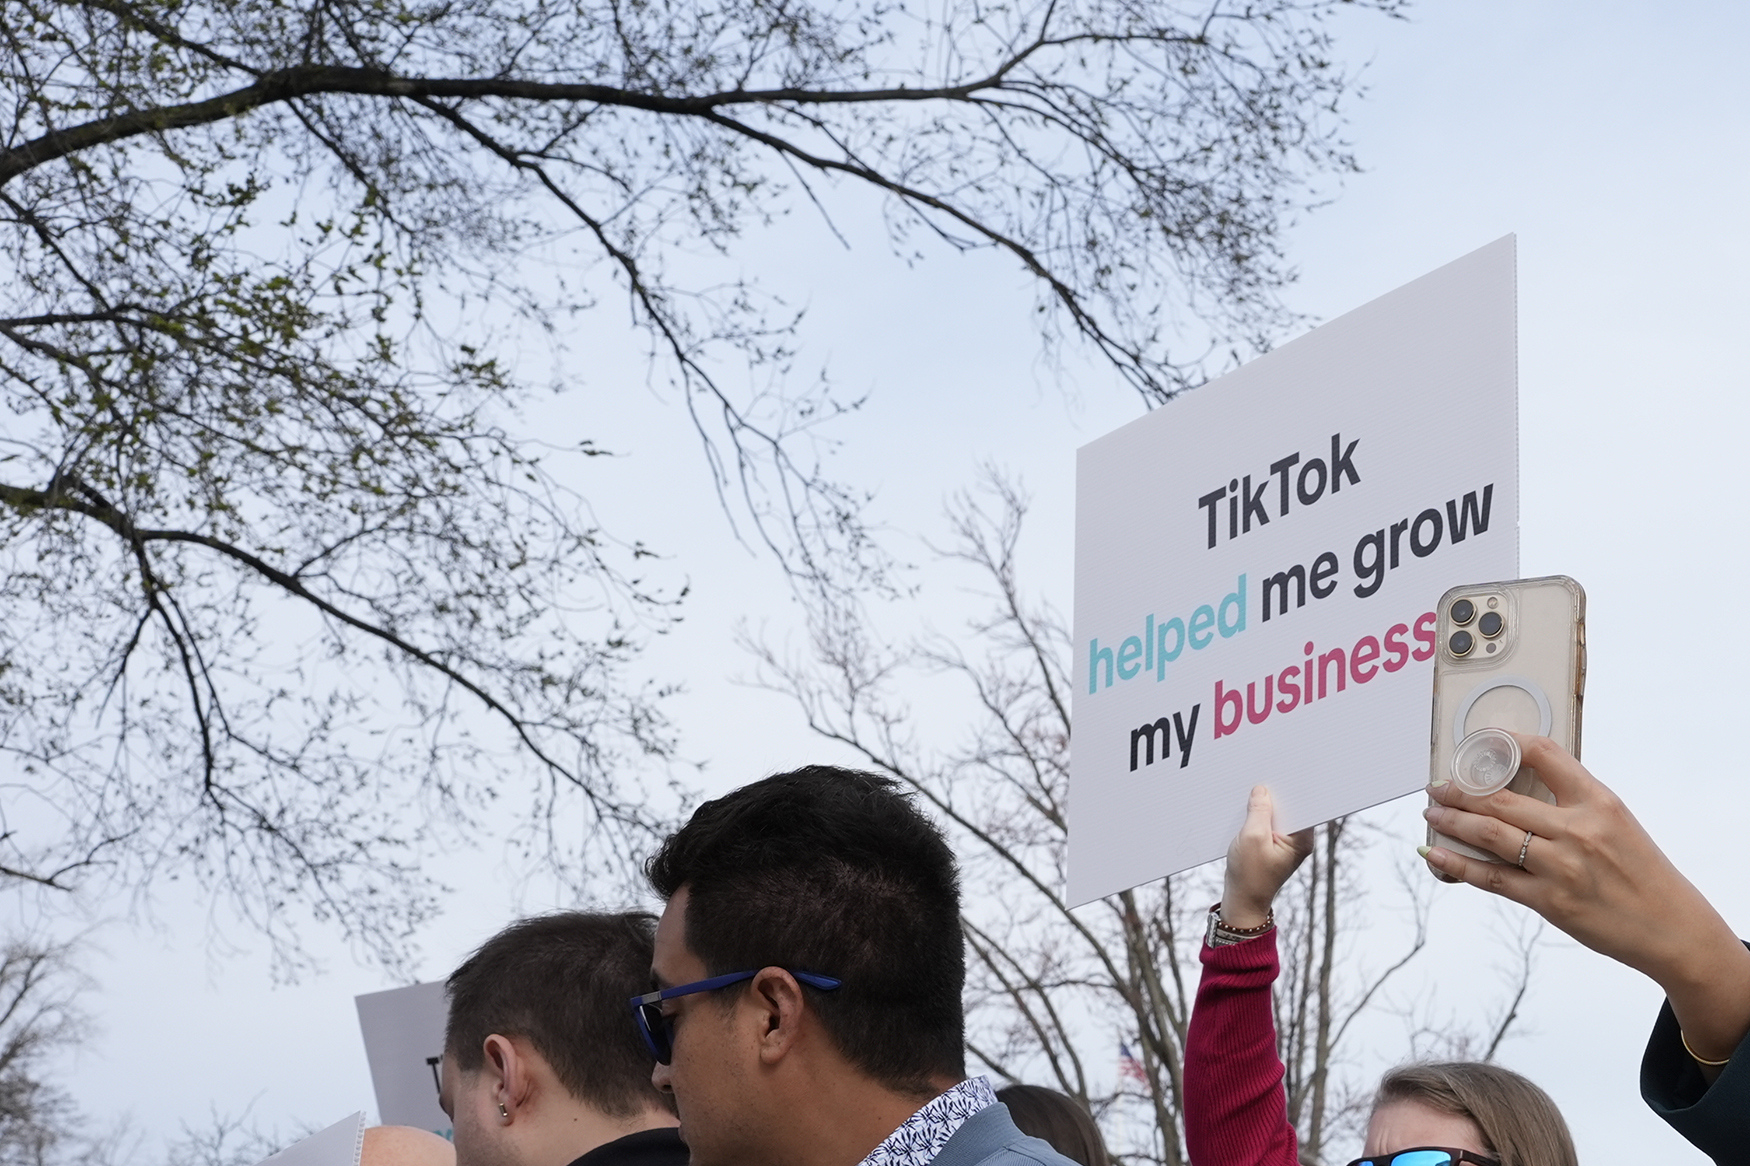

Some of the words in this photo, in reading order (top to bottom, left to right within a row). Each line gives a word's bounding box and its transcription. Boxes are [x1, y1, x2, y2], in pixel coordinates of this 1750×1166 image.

[1199, 433, 1362, 550] TikTok
[1088, 574, 1247, 695] helped
[1262, 552, 1339, 623] me
[1353, 483, 1494, 599] grow
[1130, 703, 1201, 773] my
[1214, 611, 1438, 740] business
